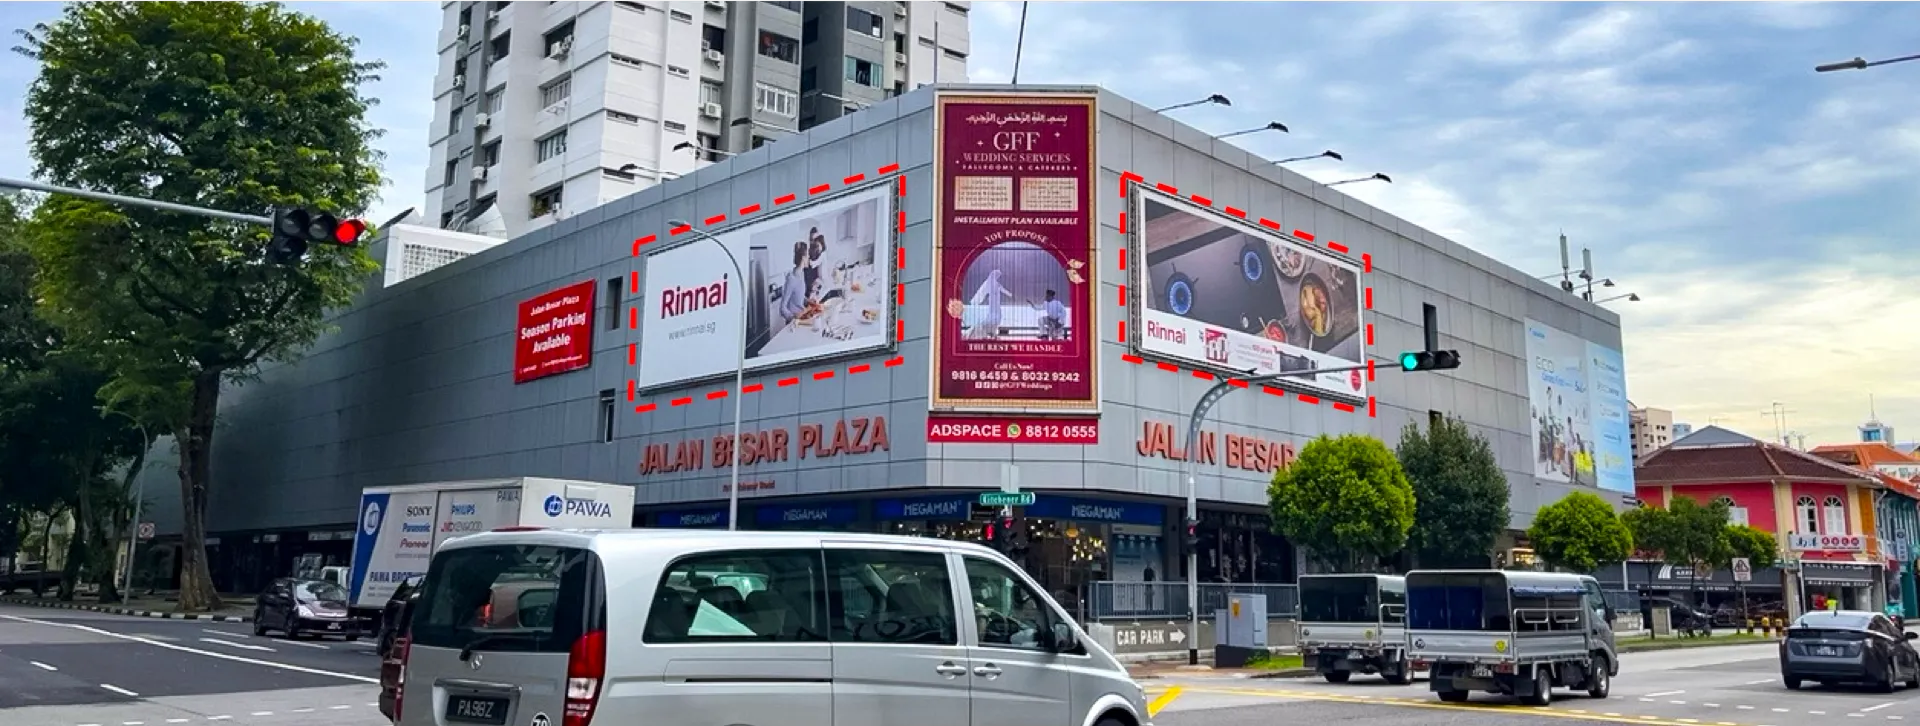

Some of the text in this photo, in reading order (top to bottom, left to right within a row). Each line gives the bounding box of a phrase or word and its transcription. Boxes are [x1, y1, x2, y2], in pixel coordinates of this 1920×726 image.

[993, 131, 1041, 151] GFF
[962, 152, 1071, 163] WEDDING SERVICES
[953, 216, 1079, 226] INSTALLMENT PLAN AVAILABLE
[984, 229, 1049, 243] YOU PROPOSE
[562, 295, 580, 306] Plaza
[660, 272, 728, 320] Rinnai
[521, 312, 587, 340] Season Parking
[1147, 320, 1187, 345] Rinnai
[532, 333, 571, 354] Available
[968, 343, 1063, 353] THE BEST WE HANDLE
[951, 370, 1080, 383] 9816 6459 & 8032 9242
[930, 424, 1096, 438] ADSPACE 8812 0555
[639, 416, 890, 476] JALAN BESAR PLAZA
[496, 490, 519, 503] PAWA
[982, 493, 1031, 504] Kitchener Rd
[406, 505, 432, 517] SONY
[565, 500, 612, 518] PAWA
[783, 509, 828, 521] MEGAMAN
[903, 501, 958, 516] MEGAMAN
[1071, 504, 1121, 519] MEGAMAN
[680, 513, 717, 526] MEGAMAN
[402, 522, 431, 533] Panasonic
[400, 537, 430, 548] Pioneer
[1117, 628, 1165, 646] CAR PARK
